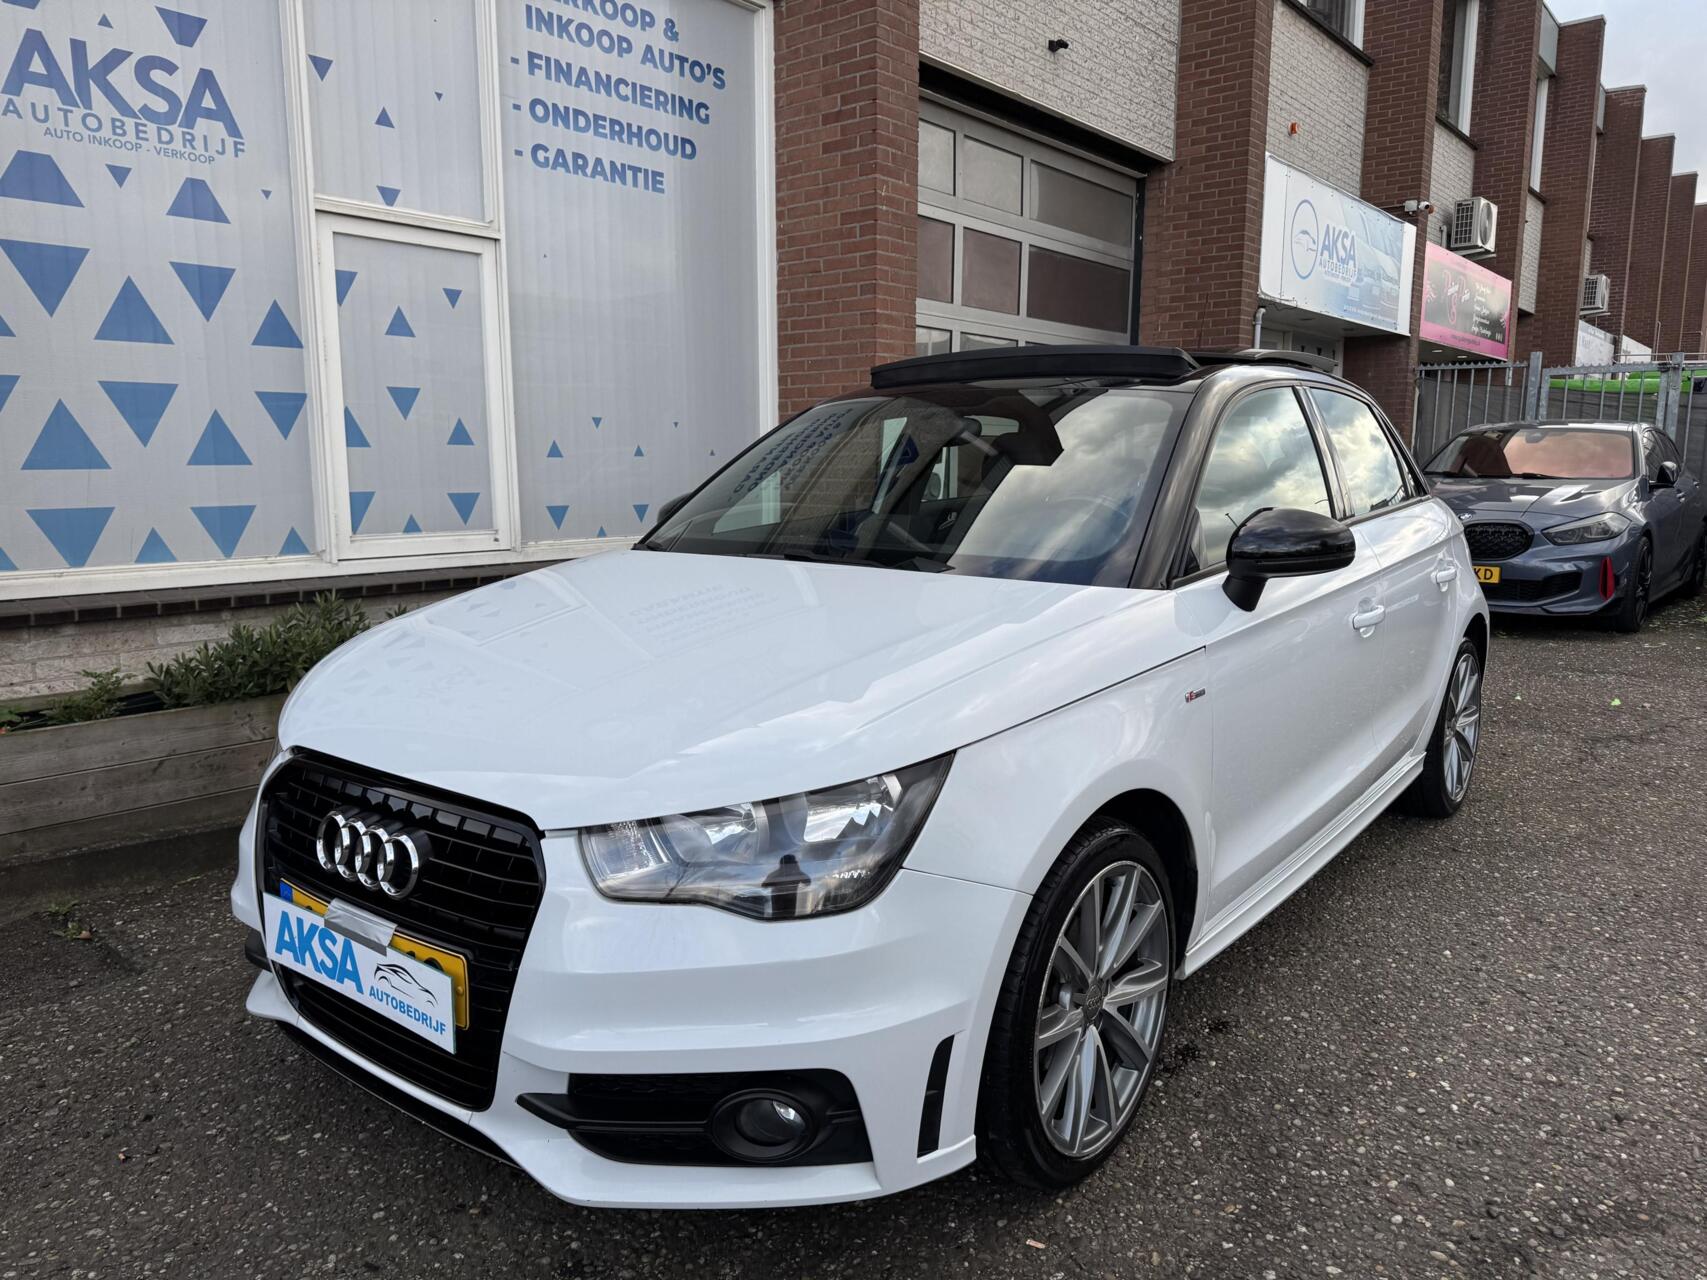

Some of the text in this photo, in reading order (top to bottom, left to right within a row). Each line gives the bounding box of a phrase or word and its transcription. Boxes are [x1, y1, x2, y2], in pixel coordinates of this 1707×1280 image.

[526, 4, 726, 90] INKOOP AUTO'S
[663, 17, 680, 42] &
[0, 28, 244, 140] AKSA
[527, 50, 710, 125] FINANCIERING
[1, 97, 246, 158] AUTOBEDRIJF
[43, 126, 84, 142] AUTO
[87, 136, 142, 153] INKOOP
[154, 148, 216, 166] VERKOOP
[528, 97, 697, 160] ONDERHOUD
[530, 143, 665, 194] GARANTIE
[1320, 224, 1357, 272] AKSA
[274, 910, 365, 995] AKSA
[368, 985, 447, 1036] AUTOBEDRIJF
